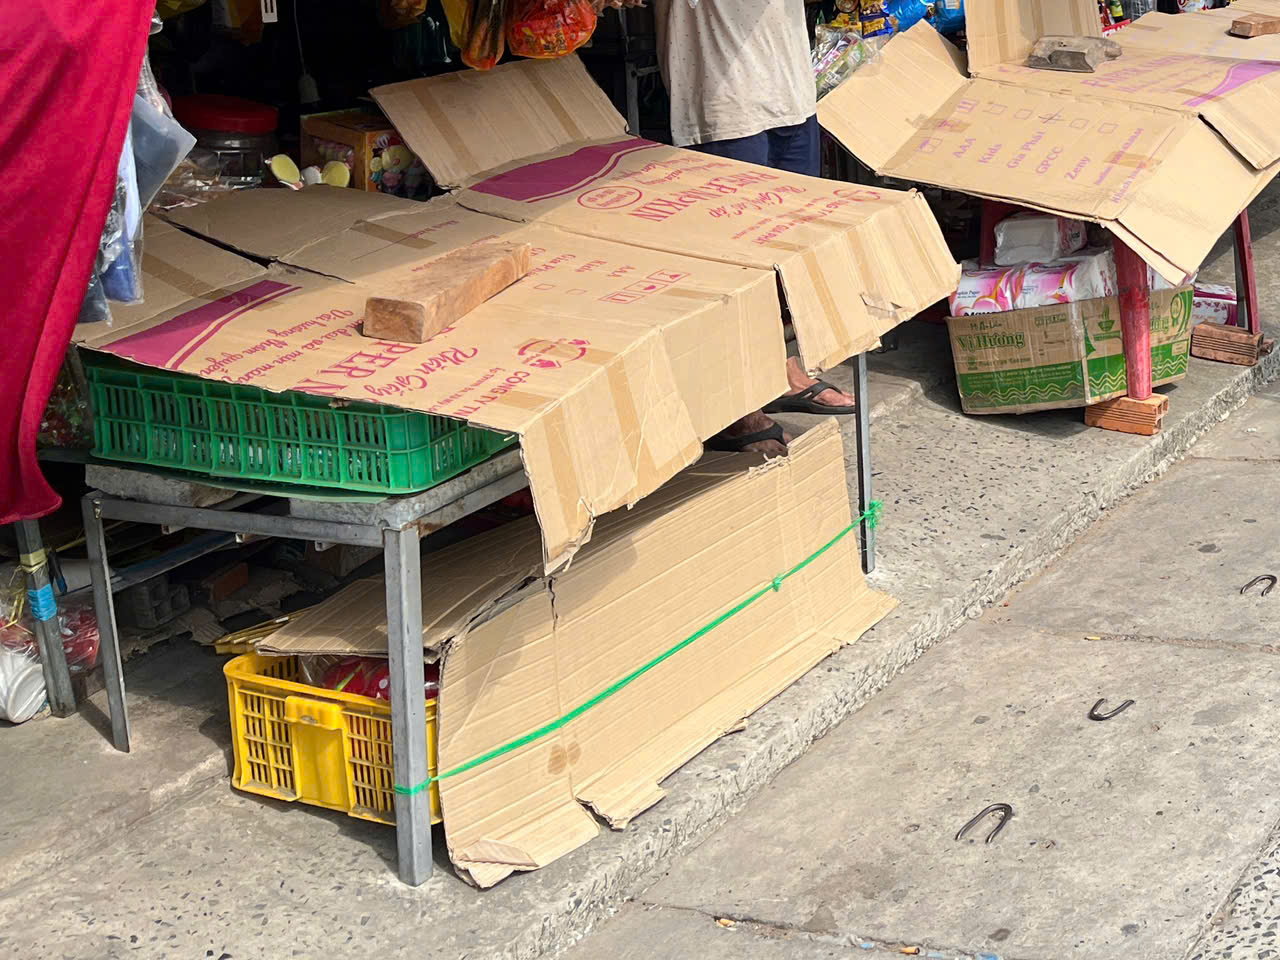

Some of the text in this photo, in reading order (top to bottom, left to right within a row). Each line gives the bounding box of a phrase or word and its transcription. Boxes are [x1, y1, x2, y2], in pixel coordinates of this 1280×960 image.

[952, 137, 976, 159] AAA
[978, 143, 1003, 164] Kids
[1007, 151, 1027, 169] Gia
[1035, 146, 1064, 176] GPCC
[1064, 155, 1092, 180] Zeny
[415, 346, 478, 376] Khăn
[496, 369, 531, 396] CÔNG
[479, 394, 499, 406] TY
